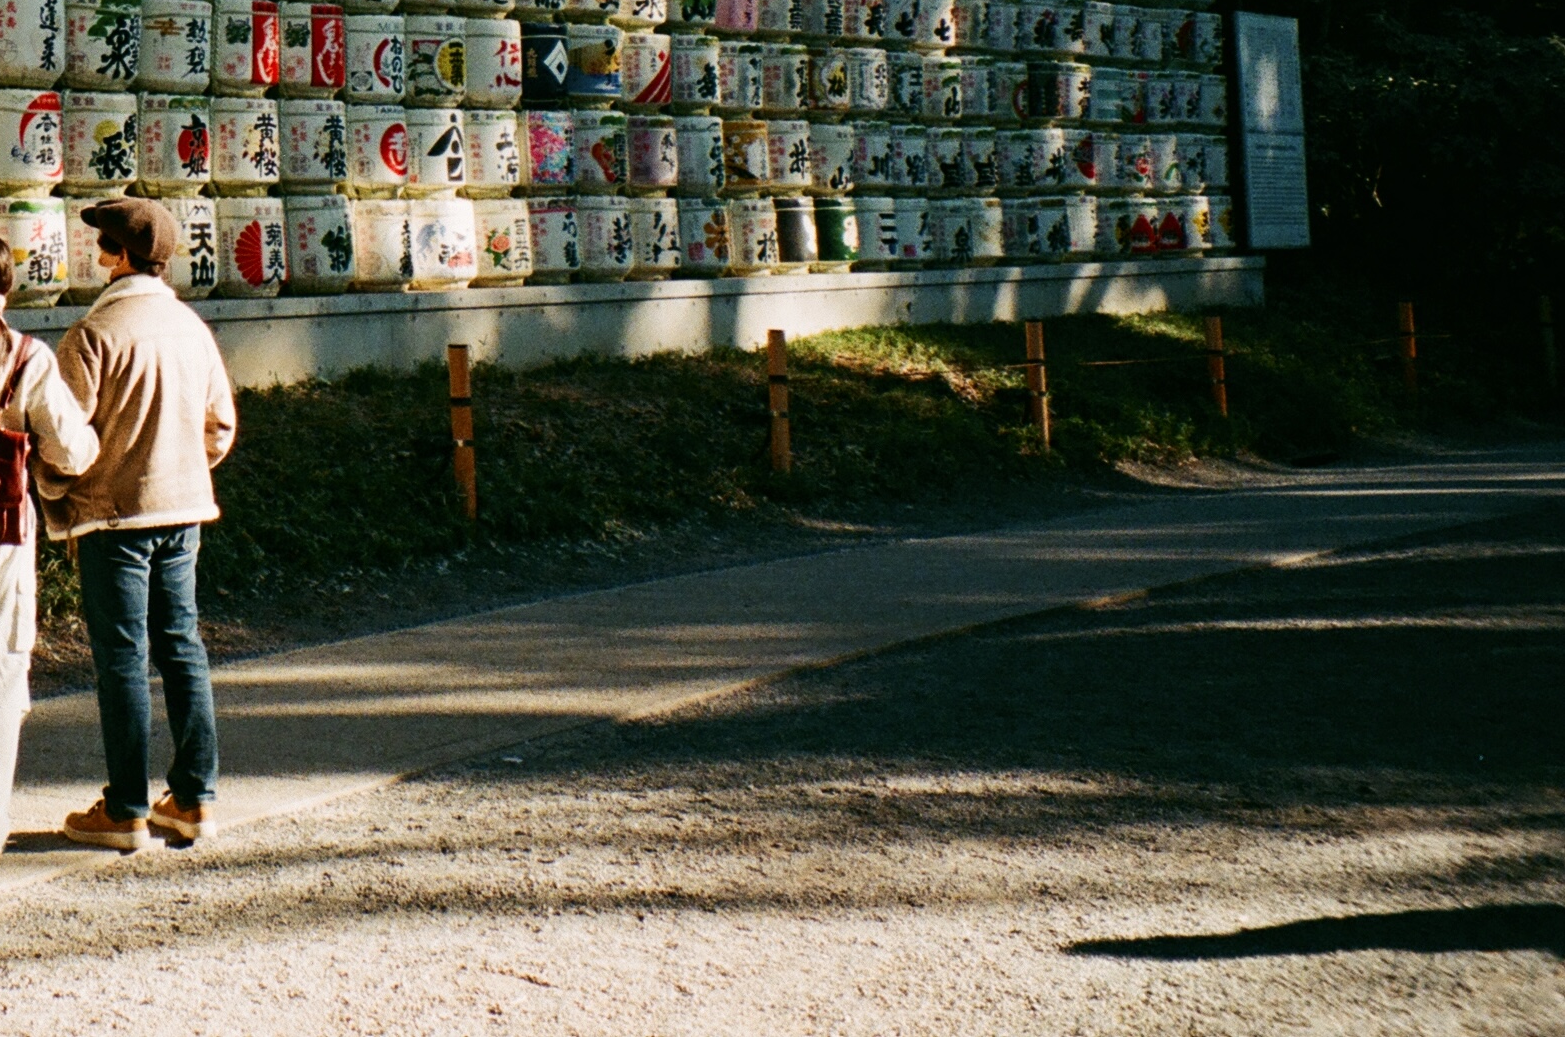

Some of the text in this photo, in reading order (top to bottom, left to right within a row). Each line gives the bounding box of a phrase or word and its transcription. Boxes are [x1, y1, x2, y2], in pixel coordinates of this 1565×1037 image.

[389, 34, 404, 94] ねのひ
[35, 112, 59, 167] 香住鶴
[180, 113, 209, 179] 京姫
[253, 112, 278, 179] 黄桜
[321, 114, 347, 179] 黄桜
[189, 222, 216, 288] 天山
[262, 222, 286, 285] 菊美人
